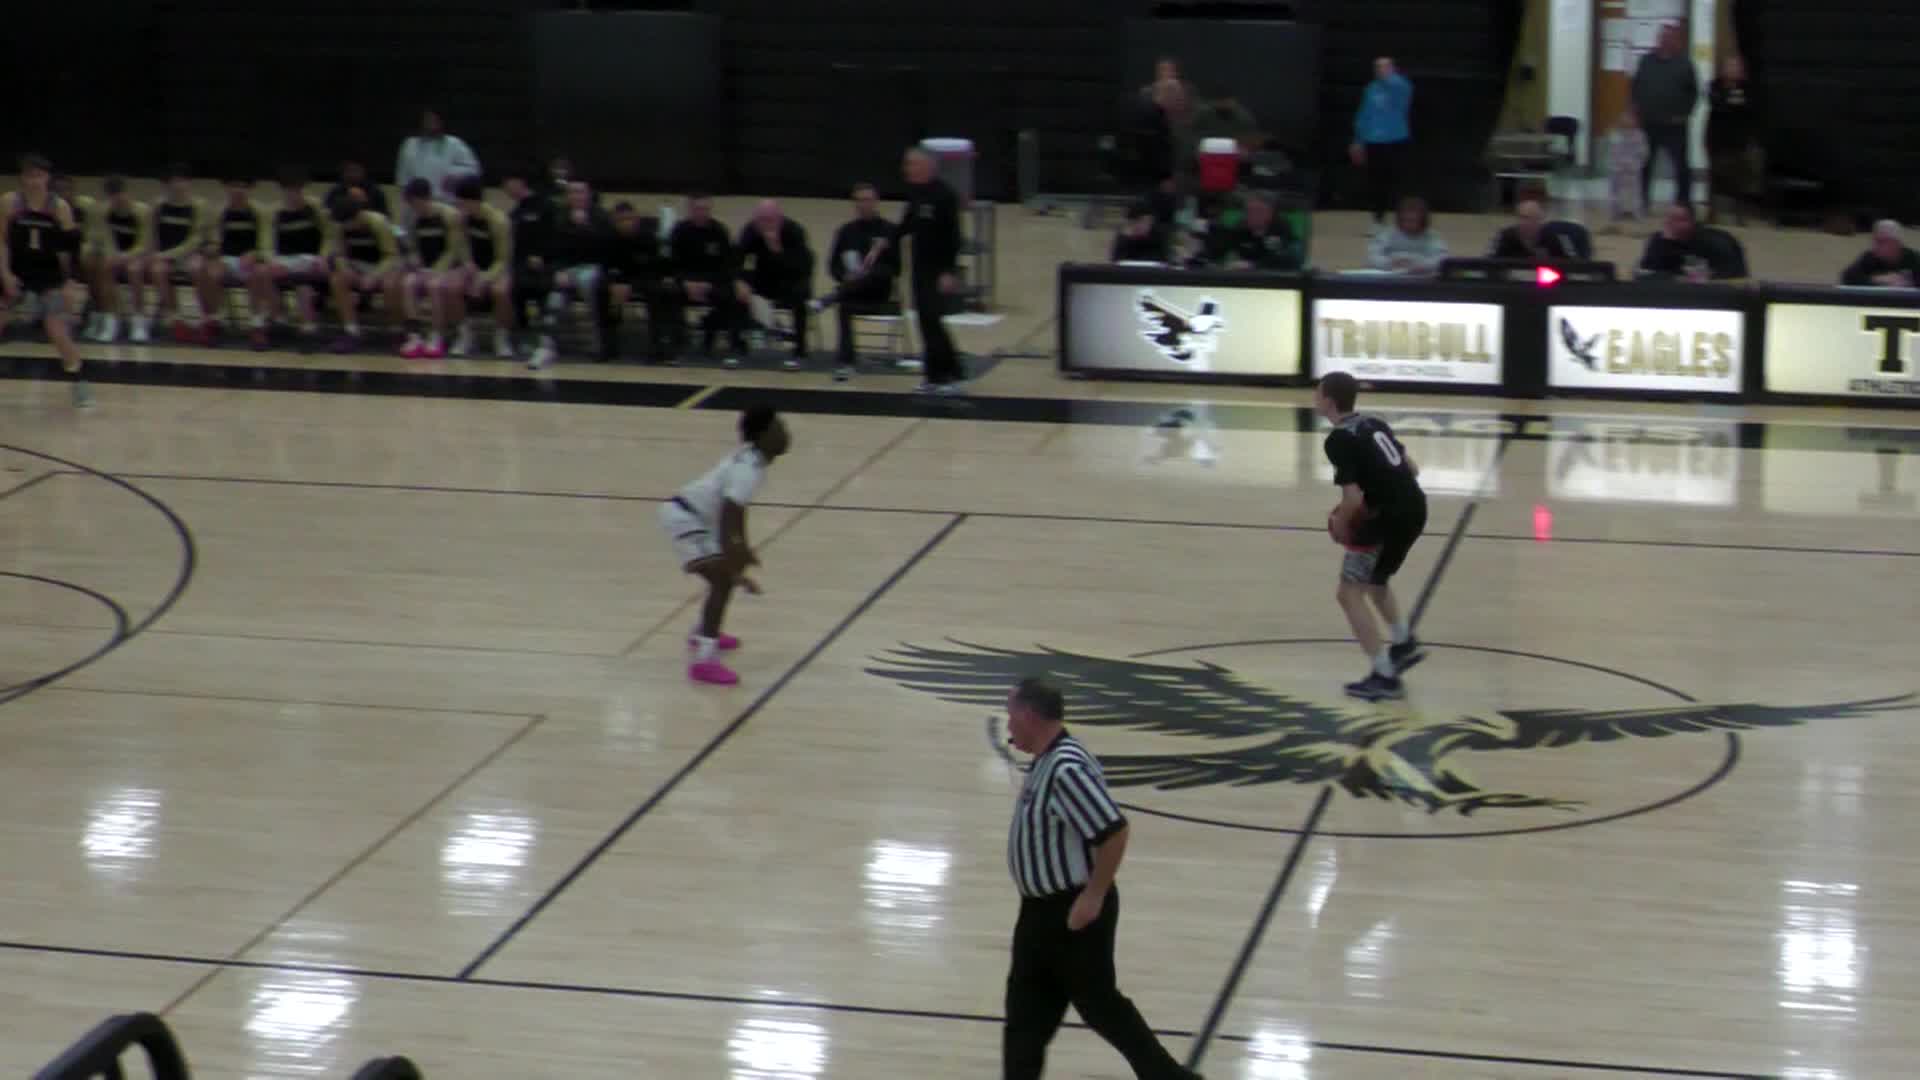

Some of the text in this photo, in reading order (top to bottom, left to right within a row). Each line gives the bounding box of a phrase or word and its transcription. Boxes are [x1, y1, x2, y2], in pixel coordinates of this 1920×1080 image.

[1320, 317, 1492, 363] TRUMBULL
[1606, 329, 1732, 378] EAGLES
[1862, 313, 1920, 374] T
[1373, 430, 1402, 467] 0
